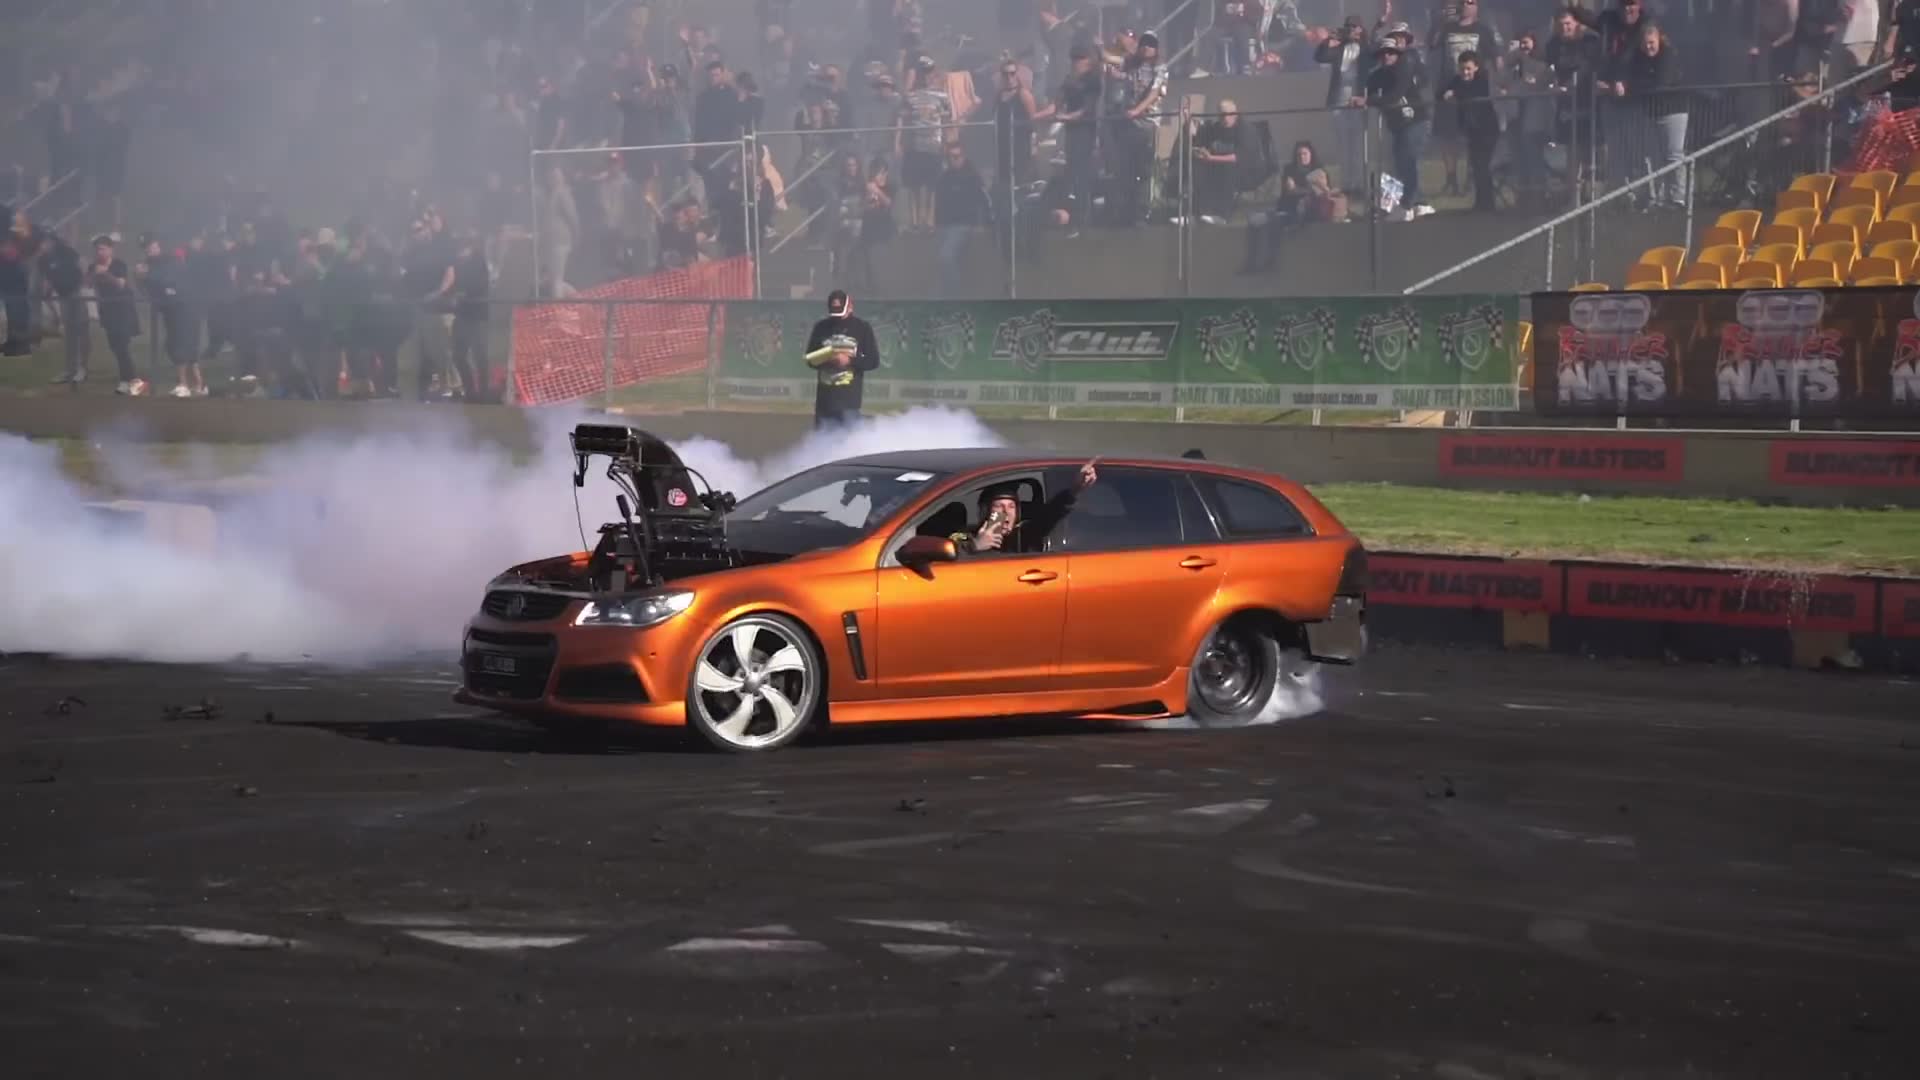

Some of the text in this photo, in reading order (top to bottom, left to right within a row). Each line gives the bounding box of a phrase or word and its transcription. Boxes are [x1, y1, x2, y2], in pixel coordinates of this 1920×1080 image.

[1053, 331, 1165, 354] Club
[1558, 359, 1667, 405] NATS
[1716, 357, 1840, 406] NATS
[1392, 387, 1515, 409] SHARE THE PASSION
[1454, 445, 1666, 471] BURNOUT MASTERS
[1784, 451, 1911, 478] BURNOUT
[1429, 570, 1543, 598] MASTERS
[1586, 580, 1856, 618] BURNOUT MASTERS
